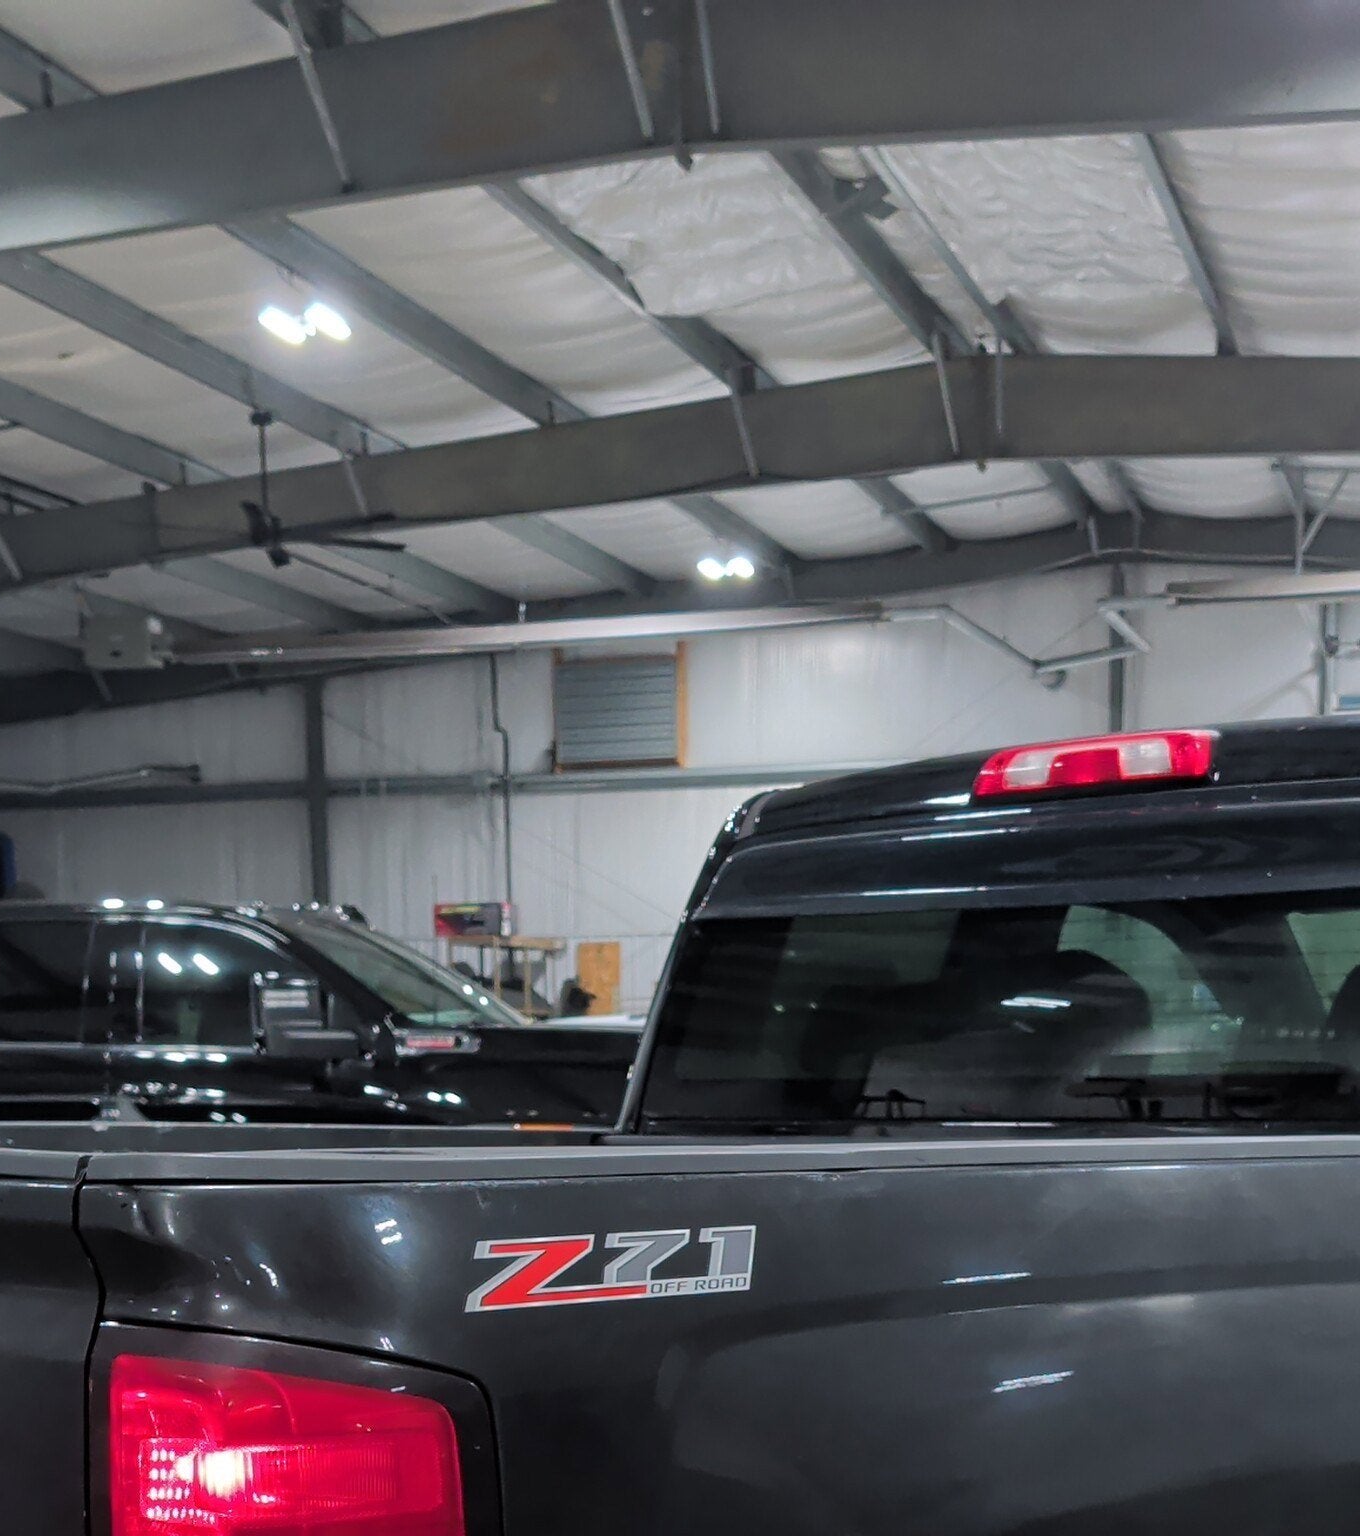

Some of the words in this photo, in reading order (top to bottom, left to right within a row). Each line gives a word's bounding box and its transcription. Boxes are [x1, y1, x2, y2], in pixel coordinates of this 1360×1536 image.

[464, 1224, 756, 1313] Z71
[651, 1281, 688, 1294] OFF
[694, 1277, 747, 1290] ROAD
